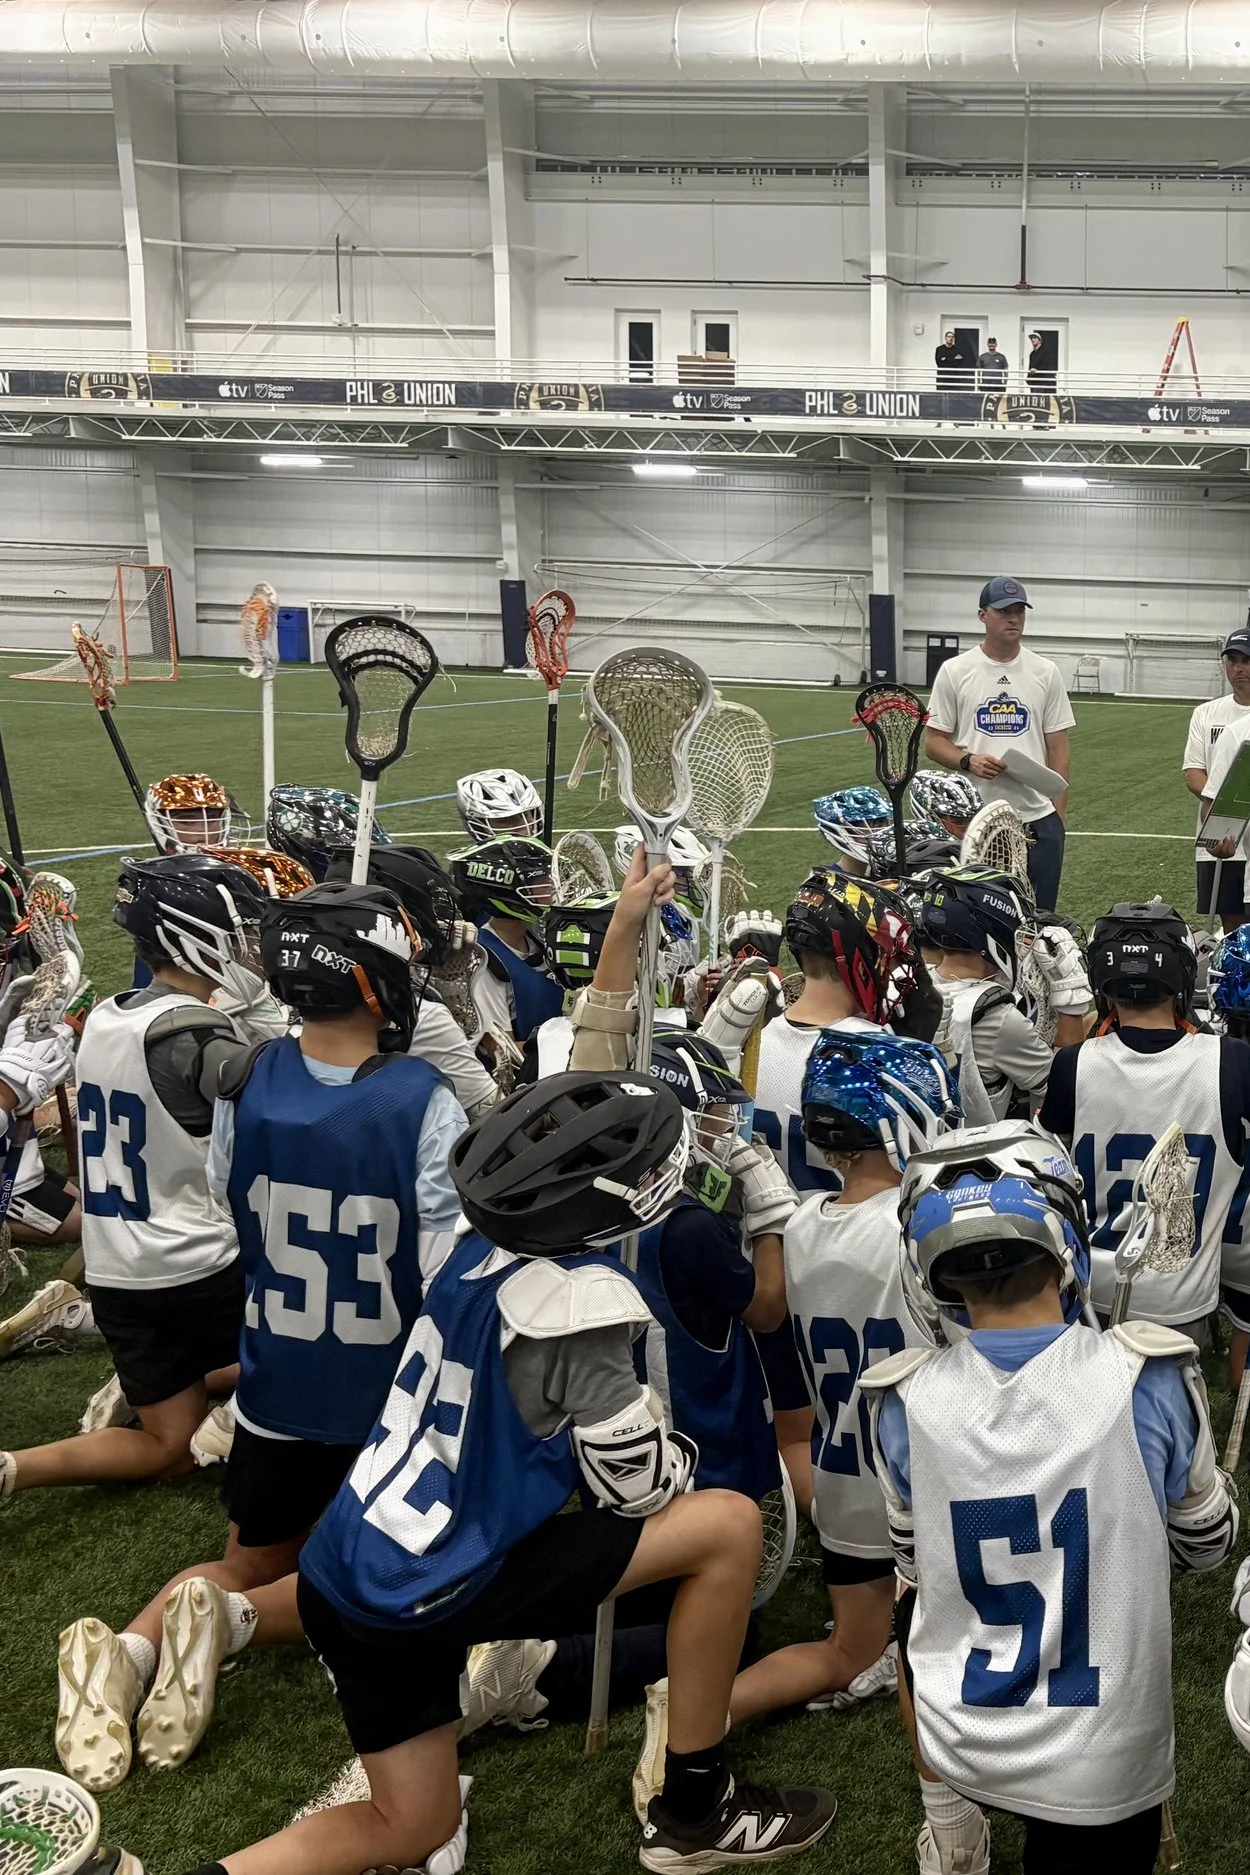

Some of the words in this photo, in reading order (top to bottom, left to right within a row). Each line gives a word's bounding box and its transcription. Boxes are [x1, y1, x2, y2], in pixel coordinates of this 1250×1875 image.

[231, 382, 248, 398] tv
[267, 383, 295, 392] Season
[345, 381, 378, 404] PHL
[403, 382, 456, 405] UNION
[543, 384, 575, 396] UNION
[267, 391, 286, 399] Pass
[685, 393, 703, 408] tv
[723, 393, 751, 402] Season
[1011, 395, 1046, 408] UNION
[723, 401, 742, 410] Pass
[804, 391, 839, 414] PHL
[865, 392, 920, 417] UNION
[1201, 406, 1230, 415] Season
[1161, 405, 1180, 422] tv
[1201, 414, 1220, 423] Pass
[989, 703, 1017, 714] CAA
[980, 713, 1024, 724] CHAMPIONS
[466, 861, 515, 885] DELCO
[981, 893, 1017, 918] FUSION
[648, 1064, 690, 1088] SION
[77, 1083, 152, 1223] 23
[951, 1486, 1101, 1709] 51
